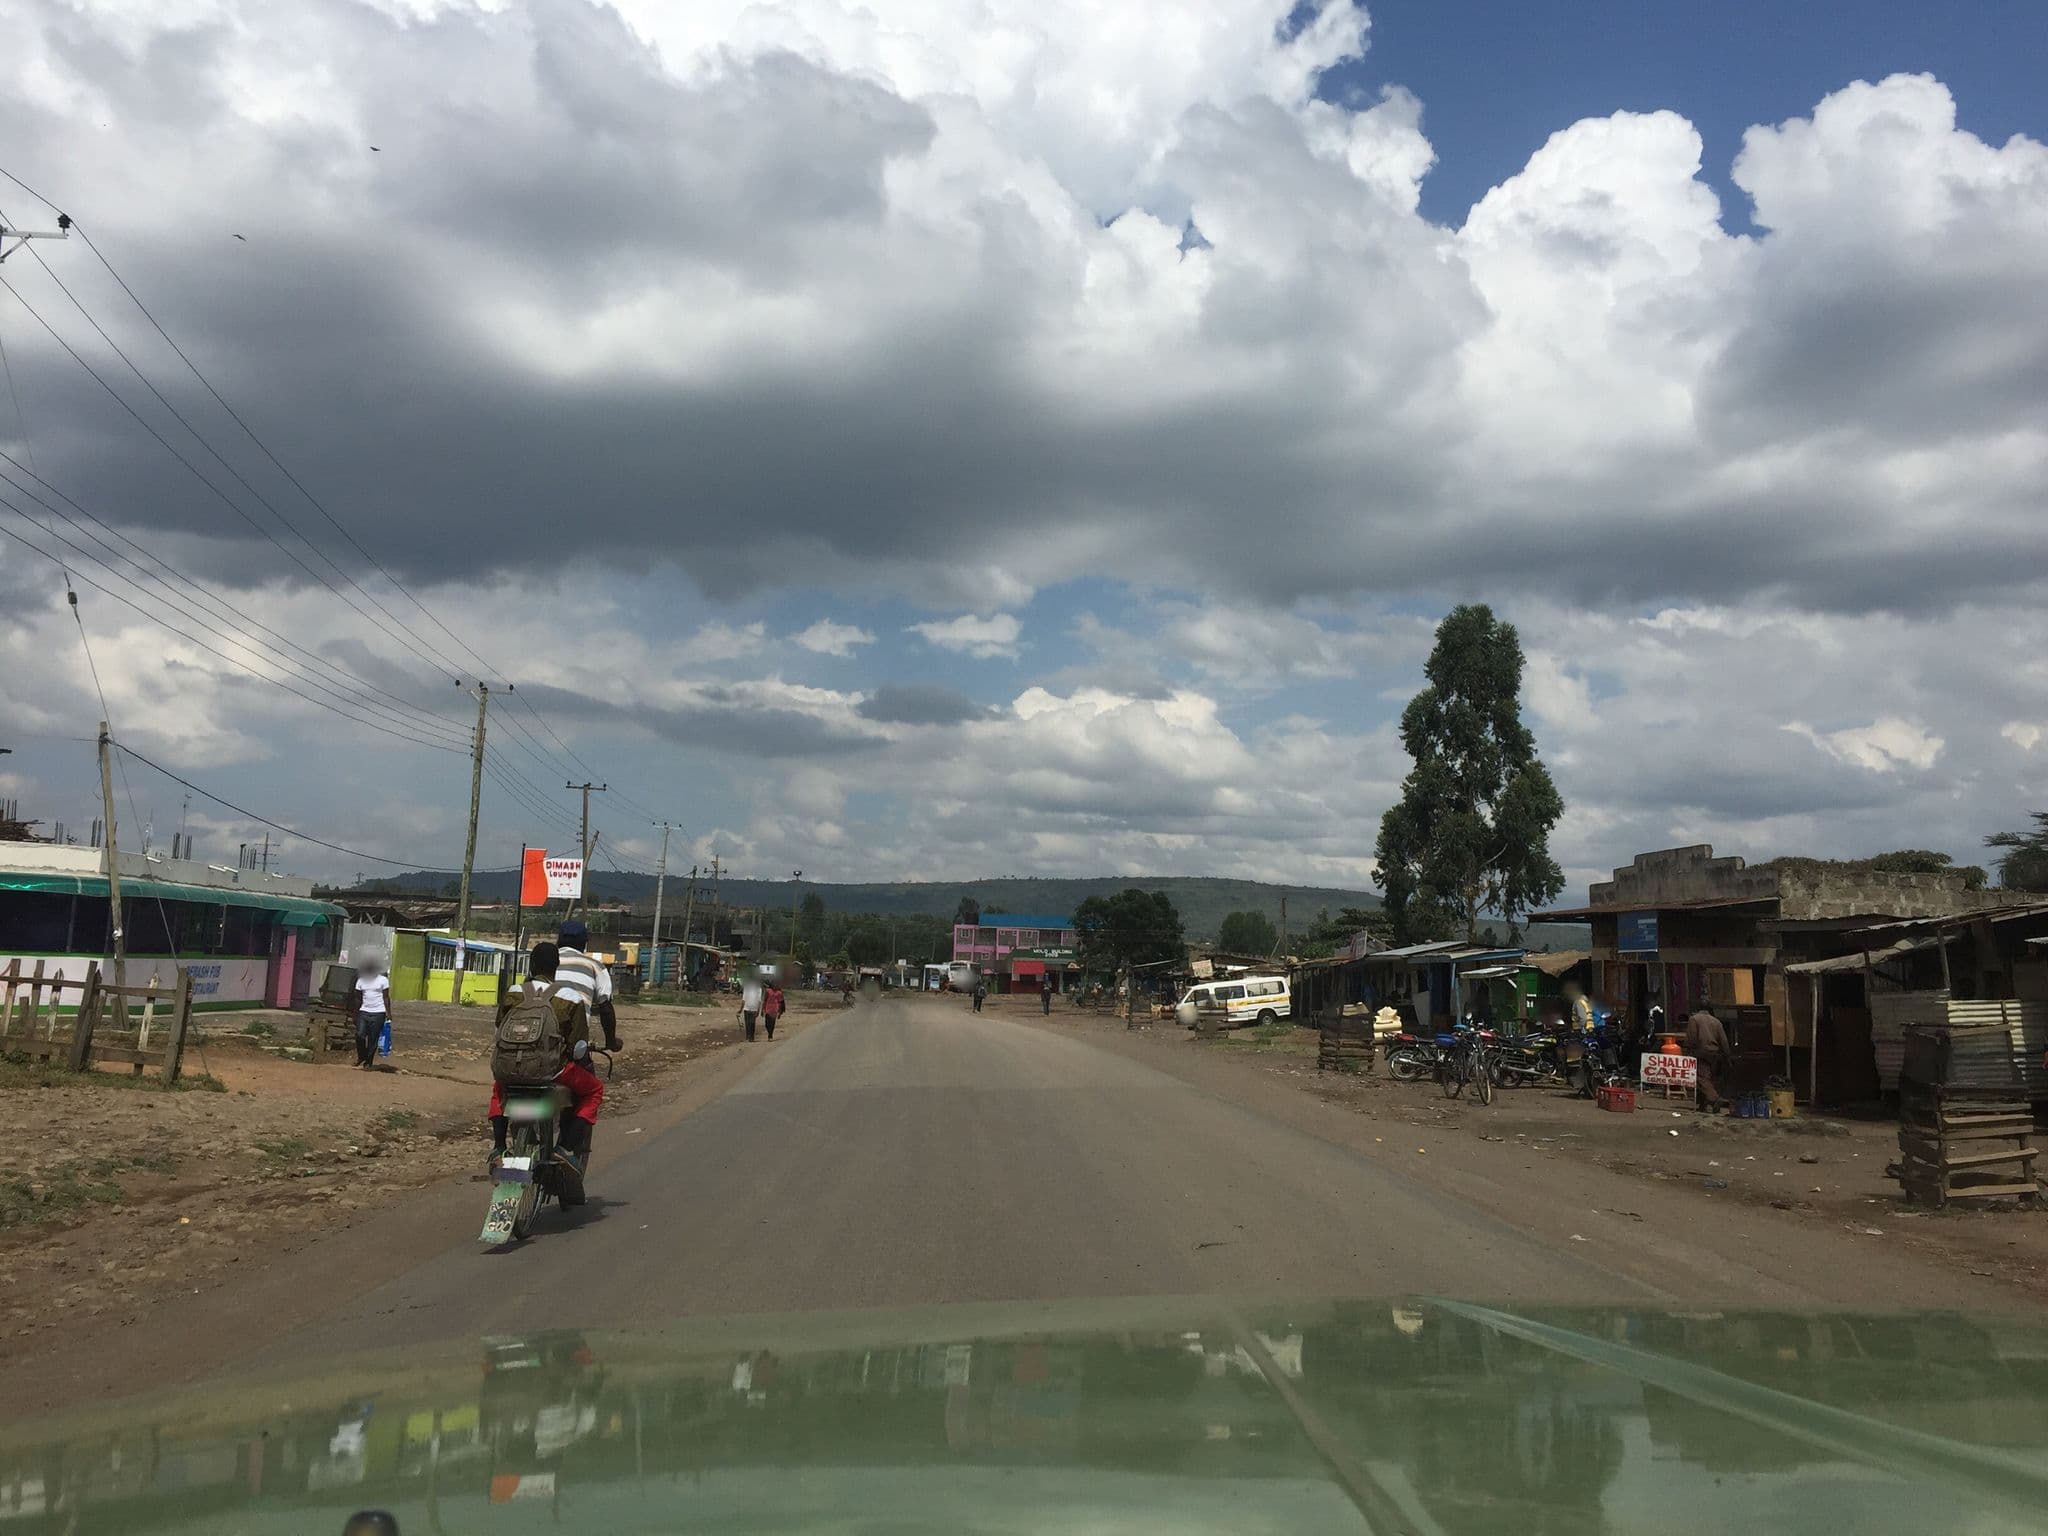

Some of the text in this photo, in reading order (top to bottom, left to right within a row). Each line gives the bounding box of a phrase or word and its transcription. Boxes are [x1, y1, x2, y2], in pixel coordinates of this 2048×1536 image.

[545, 861, 581, 870] DIMASH
[1648, 1055, 1697, 1069] SHALOM
[487, 1221, 512, 1234] GOD
